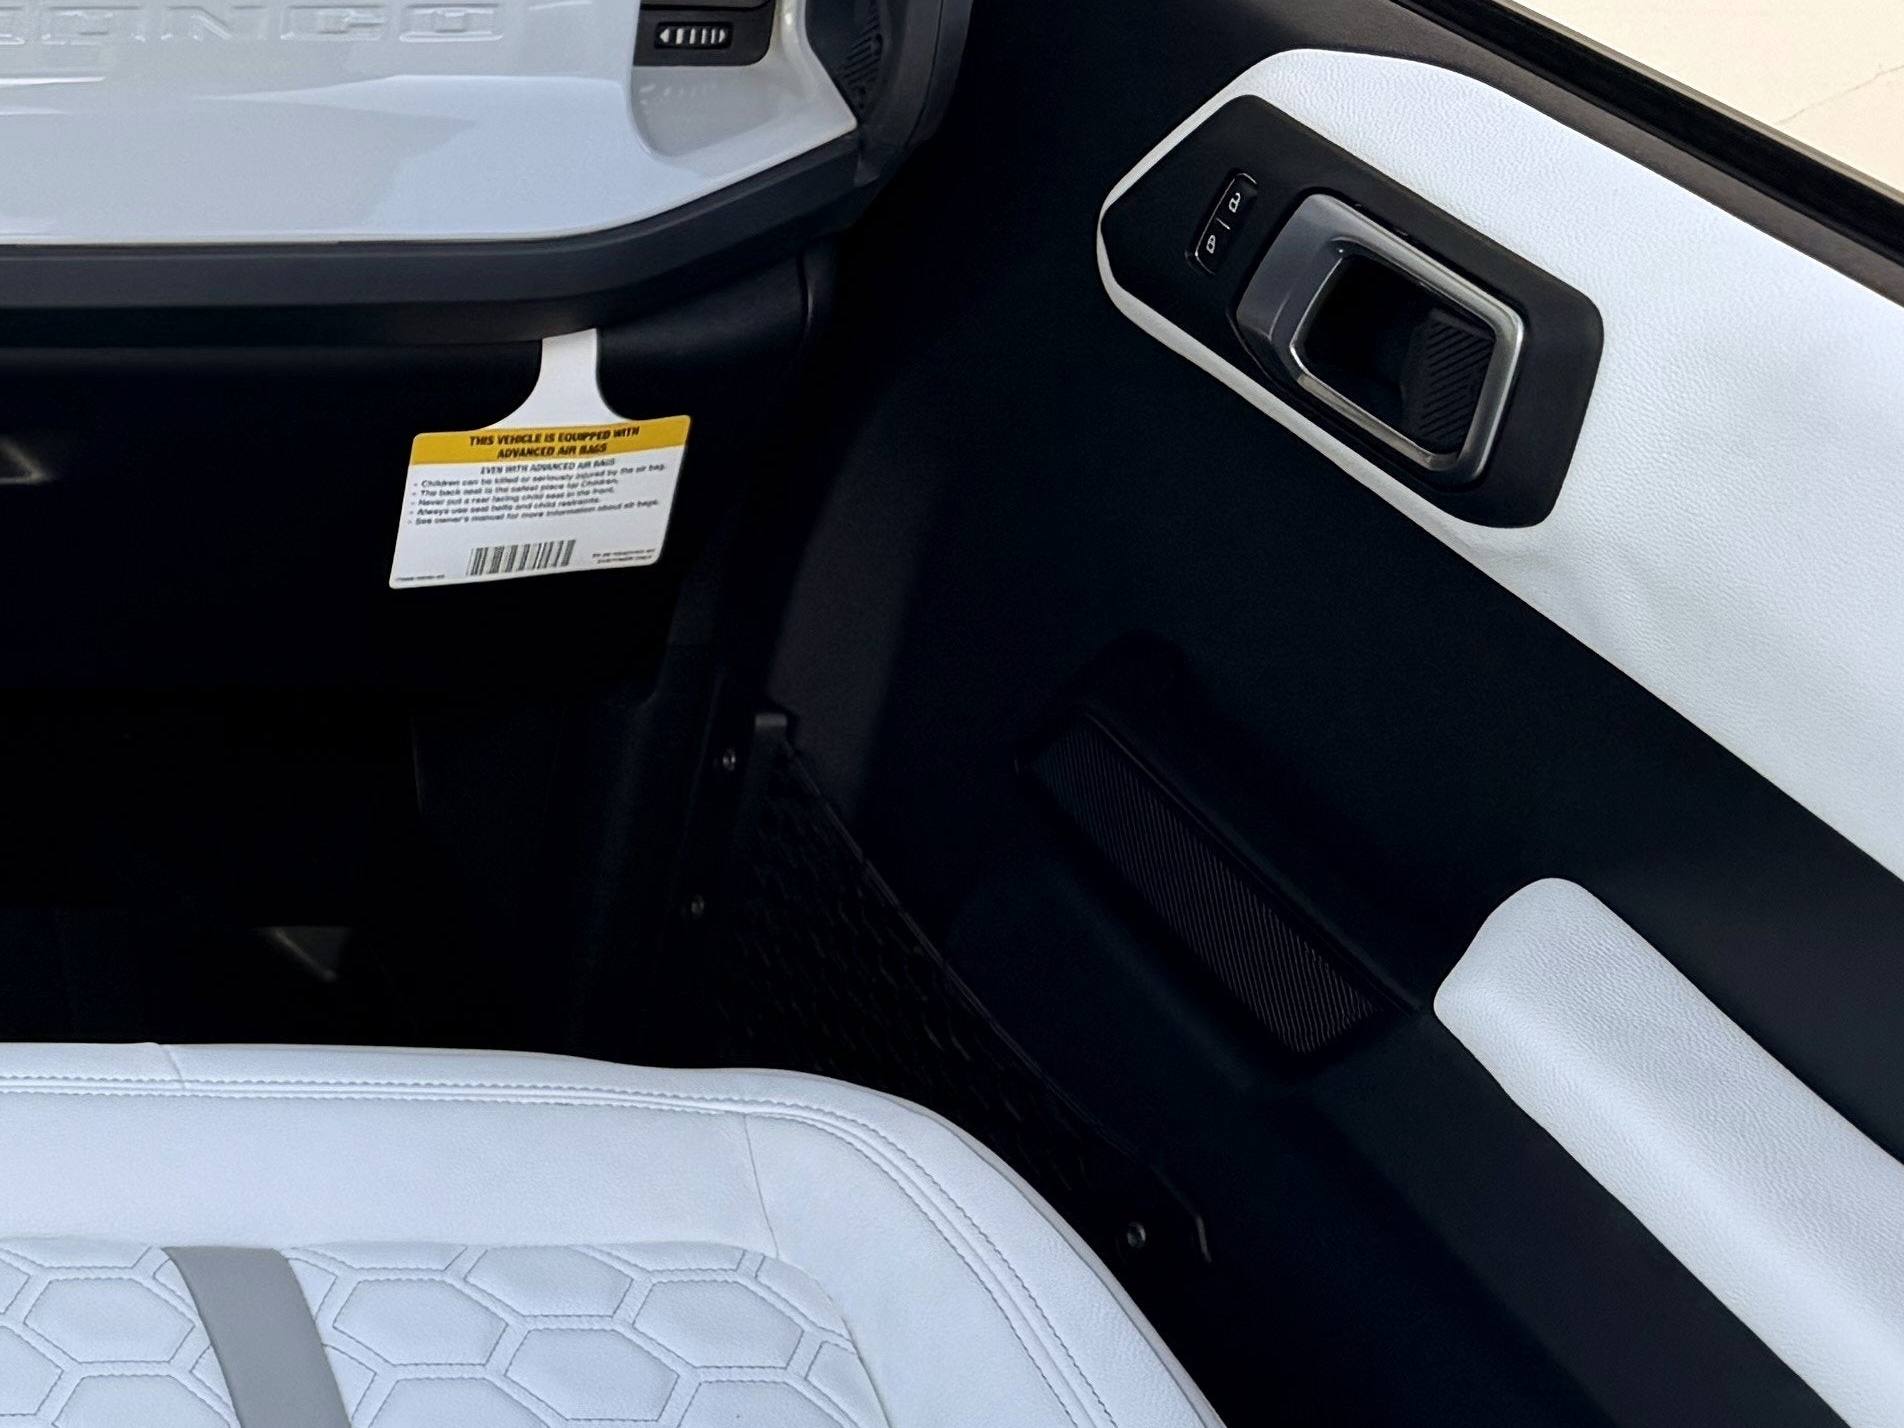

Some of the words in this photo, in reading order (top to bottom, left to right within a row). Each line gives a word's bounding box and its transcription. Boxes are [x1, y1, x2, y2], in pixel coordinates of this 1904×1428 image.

[470, 435, 494, 447] THIS
[497, 433, 541, 446] VEHICLE
[543, 432, 555, 443] IS
[558, 430, 611, 443] EQUIPPED
[613, 426, 640, 438] WITH
[497, 446, 555, 460] ADVANCED
[558, 445, 577, 456] AIR
[579, 443, 608, 455] BAGS
[529, 461, 575, 472] ADVANCED
